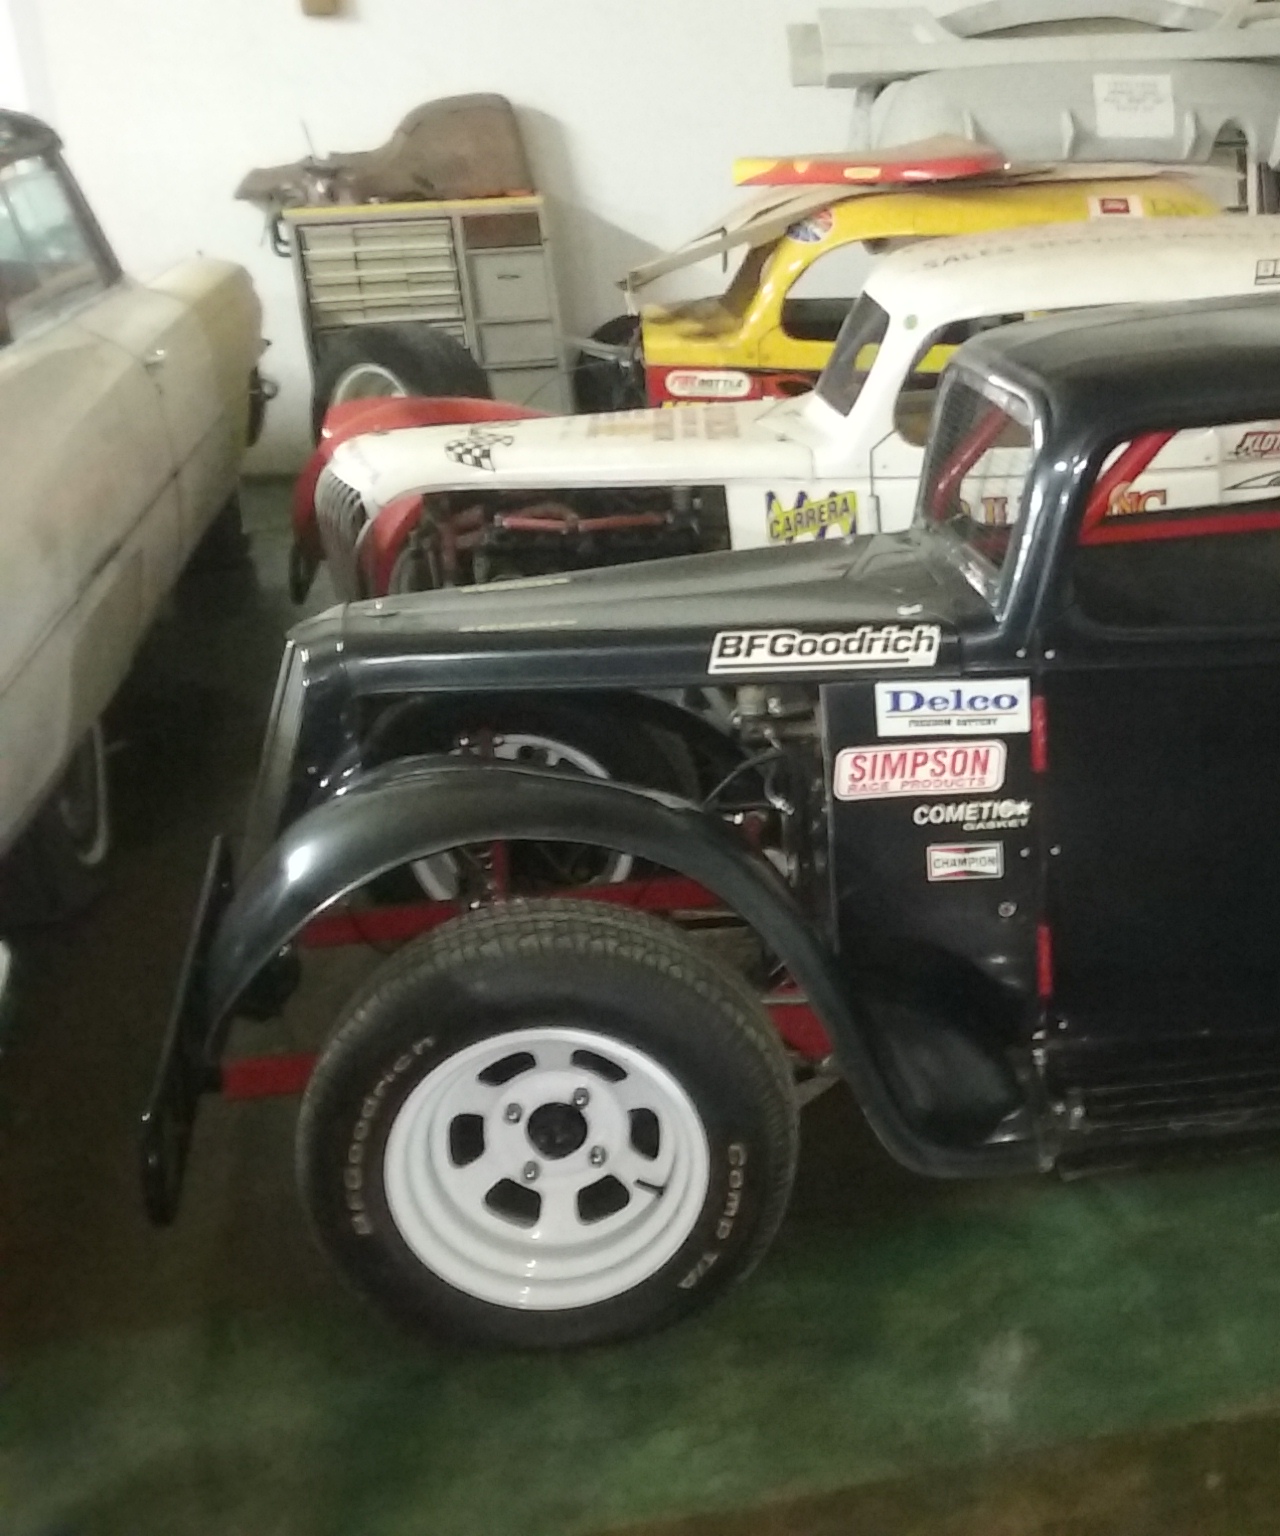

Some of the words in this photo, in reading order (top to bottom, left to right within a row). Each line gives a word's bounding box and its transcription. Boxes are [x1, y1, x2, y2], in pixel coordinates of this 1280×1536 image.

[768, 496, 851, 540] CARRERA
[716, 627, 936, 659] BFGoodrich
[884, 687, 1019, 714] Delco
[849, 748, 991, 783] SIMPSON
[847, 781, 890, 794] RACE
[900, 777, 986, 790] PRODUCTS
[913, 799, 1017, 826] COMETIC
[962, 818, 1029, 831] GASKET
[933, 856, 997, 869] CHAMPION
